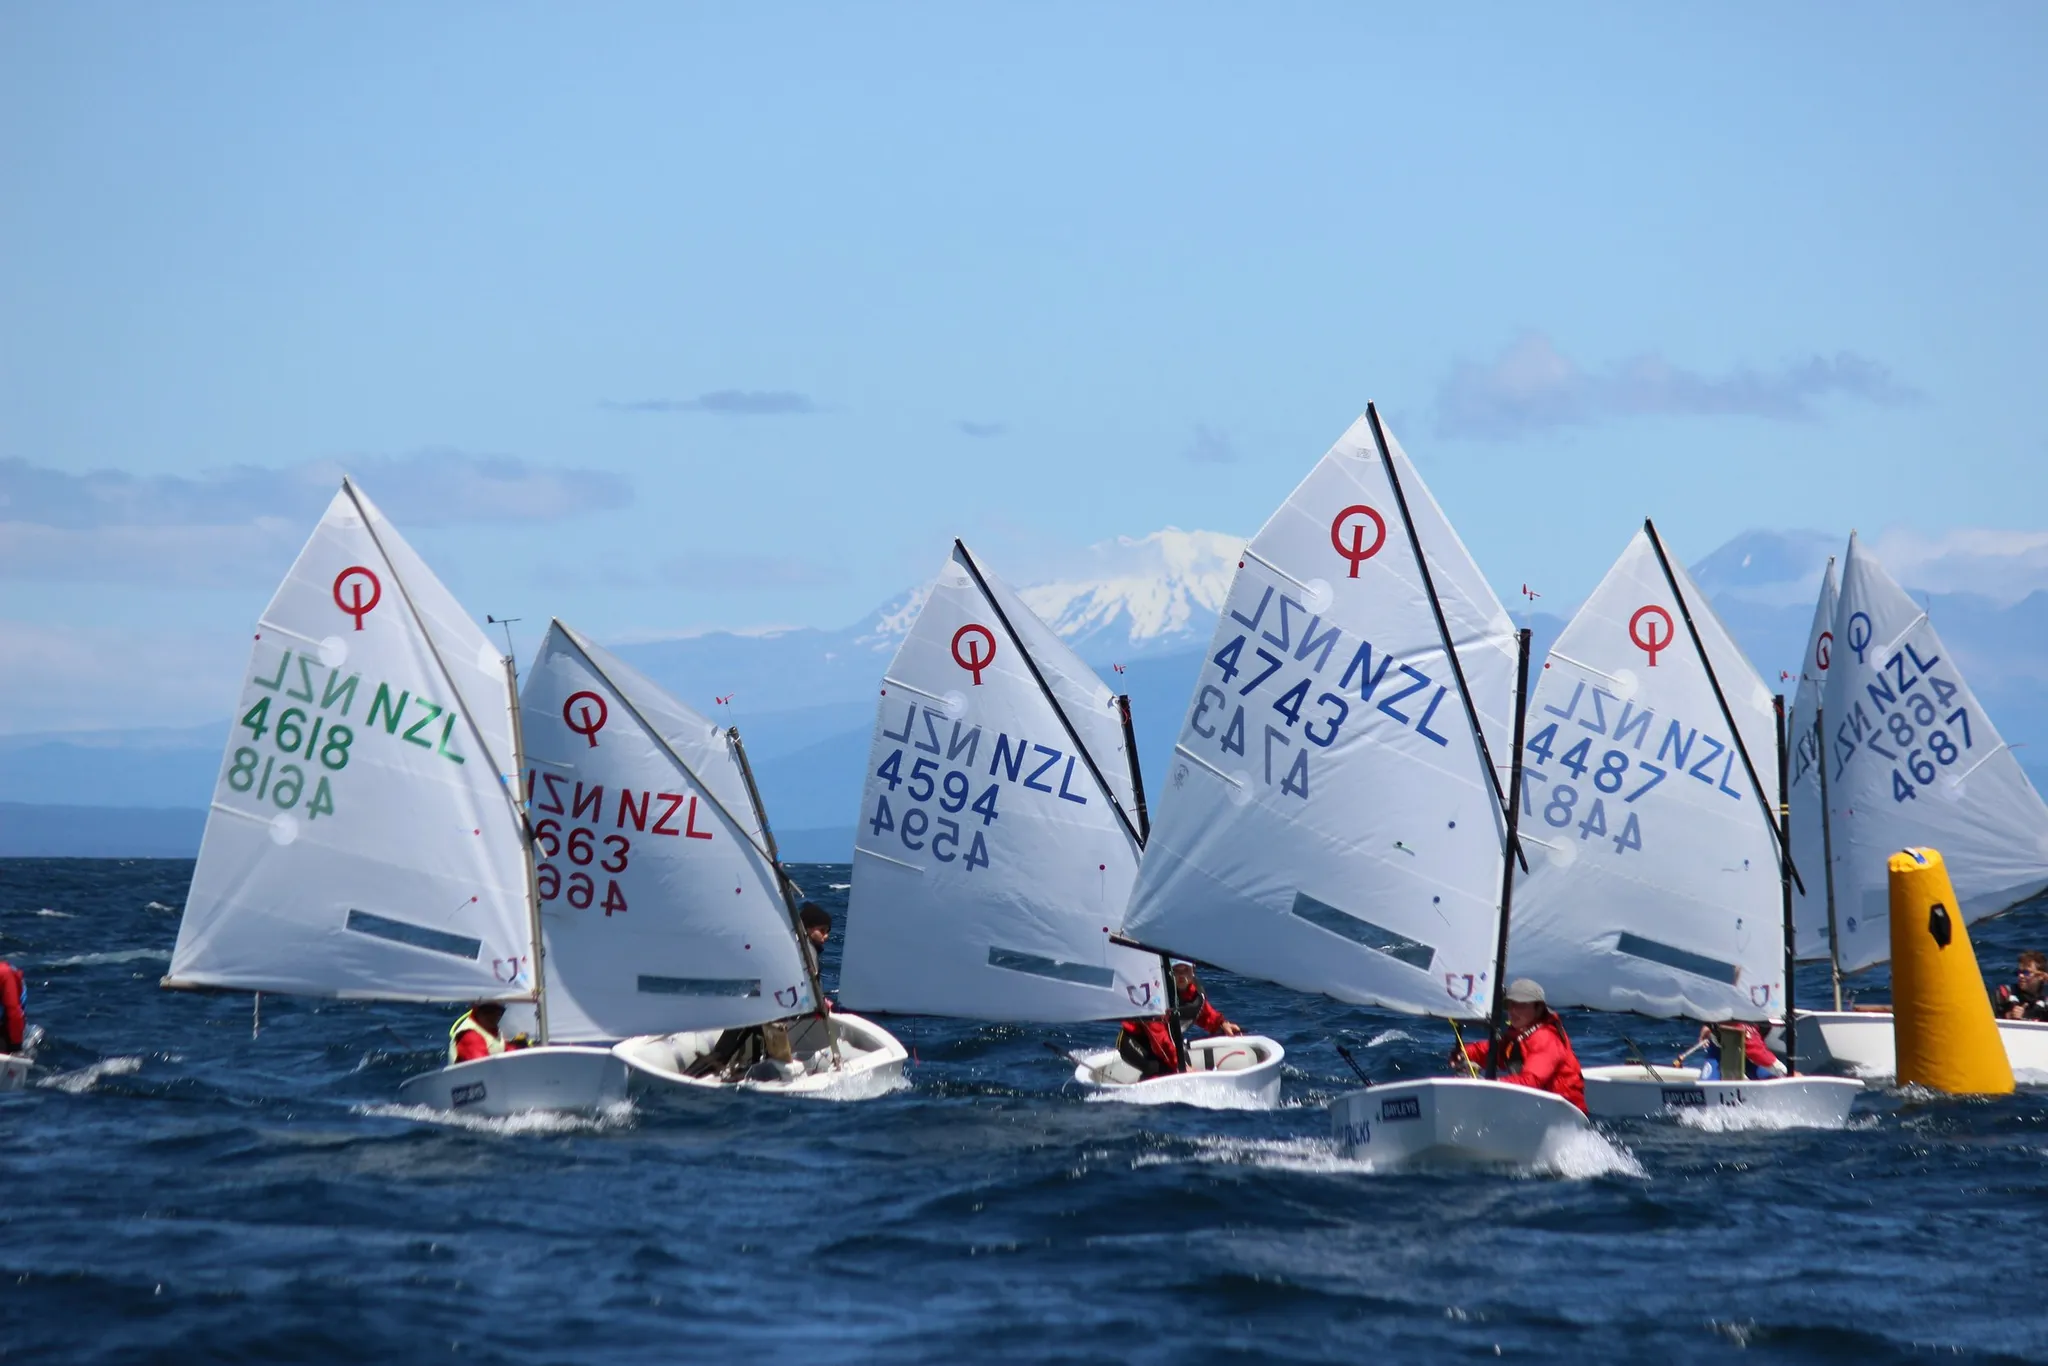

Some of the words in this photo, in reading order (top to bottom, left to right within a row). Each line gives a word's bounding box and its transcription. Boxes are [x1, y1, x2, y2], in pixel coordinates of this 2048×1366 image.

[1213, 634, 1349, 747] 4743
[1338, 640, 1449, 747] NZL
[1867, 643, 1940, 715] NZL
[241, 696, 354, 771] 4618
[366, 682, 465, 765] NZL
[1526, 722, 1667, 803] 4487
[1657, 719, 1741, 800] NZL
[1891, 707, 1973, 803] 4687
[876, 749, 1000, 826] 4594
[989, 733, 1087, 805] NZL
[535, 818, 631, 873] 663
[617, 789, 713, 840] NZL
